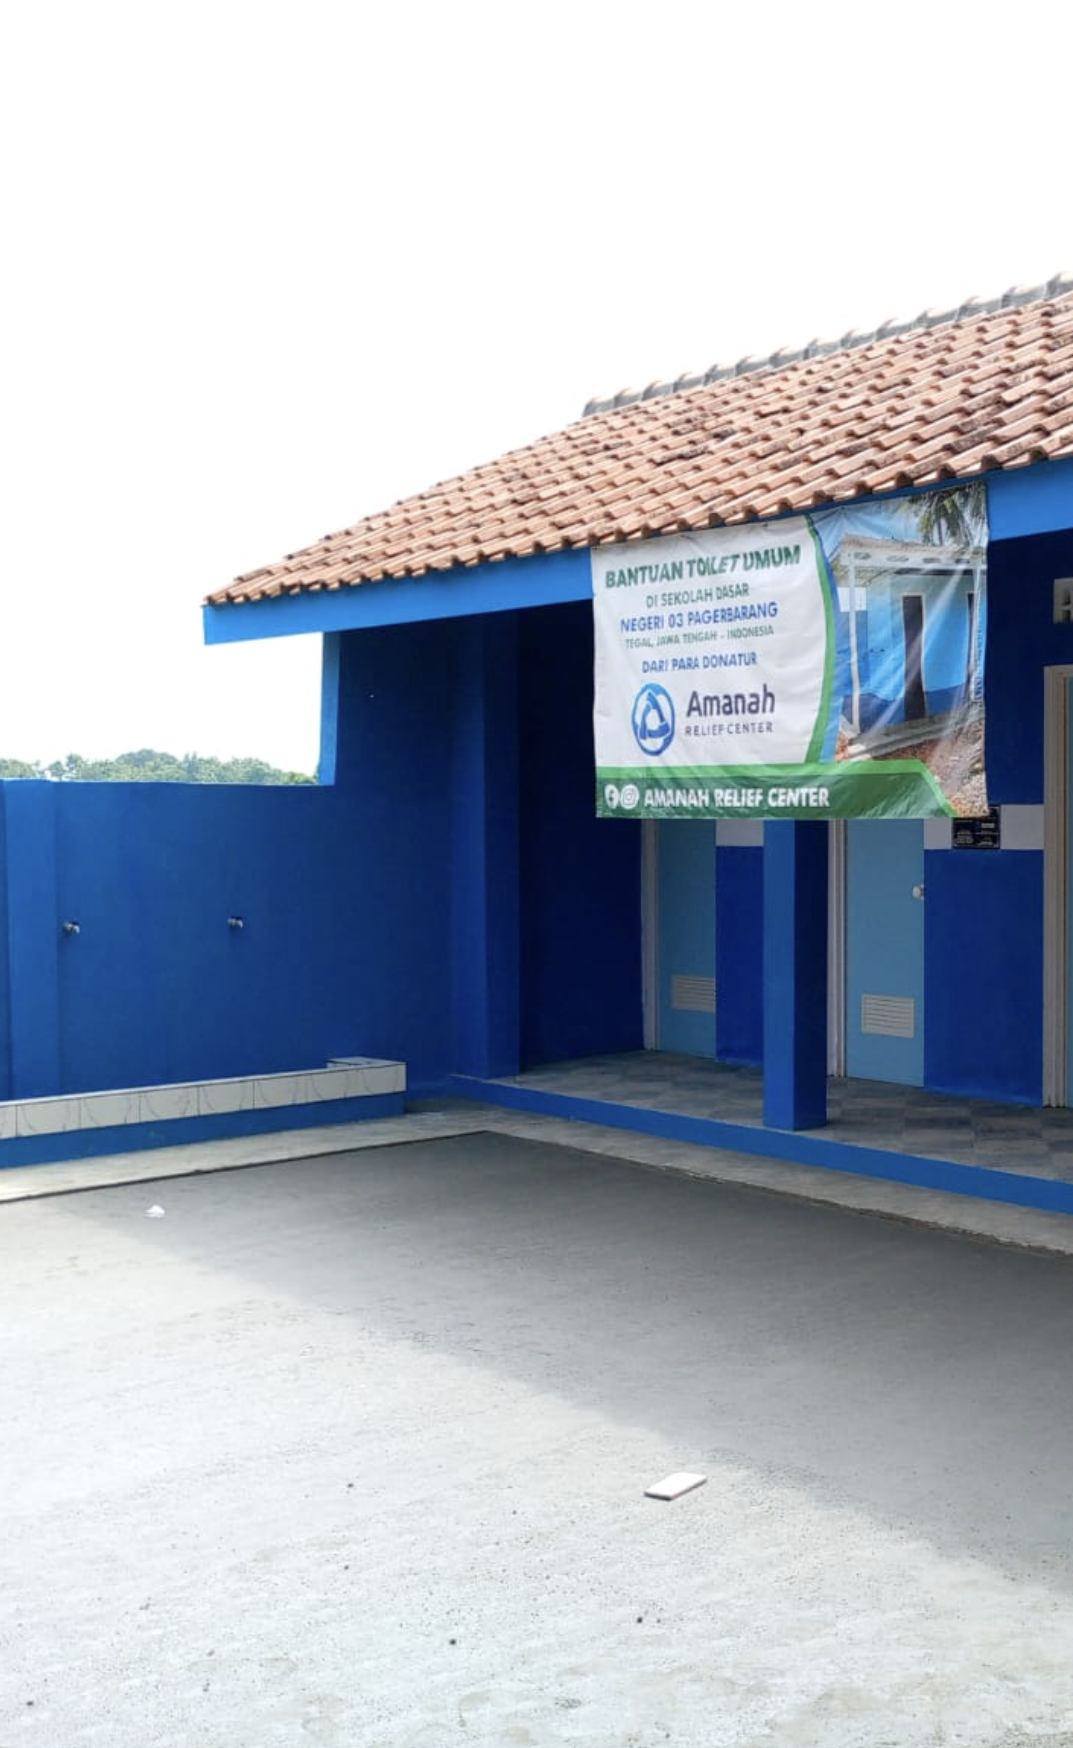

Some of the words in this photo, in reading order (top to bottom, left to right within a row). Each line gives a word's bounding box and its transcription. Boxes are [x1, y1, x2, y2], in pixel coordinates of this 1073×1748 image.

[605, 561, 684, 588] BANTUAN
[687, 555, 742, 578] TOILET
[743, 544, 801, 571] UMUM
[646, 595, 658, 609] DI
[661, 587, 713, 607] SEKOLAH
[716, 583, 750, 600] DASAR
[620, 615, 664, 632] NEGERI
[668, 612, 684, 629] 03
[688, 602, 778, 625] PAGERBARANG
[625, 637, 654, 650] TEGAL,
[656, 633, 679, 647] JAWA
[682, 632, 716, 645] TENGAH
[727, 625, 774, 640] INDONESIA
[642, 660, 668, 674] DARI
[672, 656, 699, 671] PARA
[702, 652, 757, 668] DONATUR
[686, 683, 775, 718] Amanah
[684, 724, 725, 737] RELIEF
[727, 721, 774, 734] CENTER
[644, 788, 709, 808] AMANAH
[713, 787, 766, 807] RELIEF
[767, 786, 829, 808] CENTER
